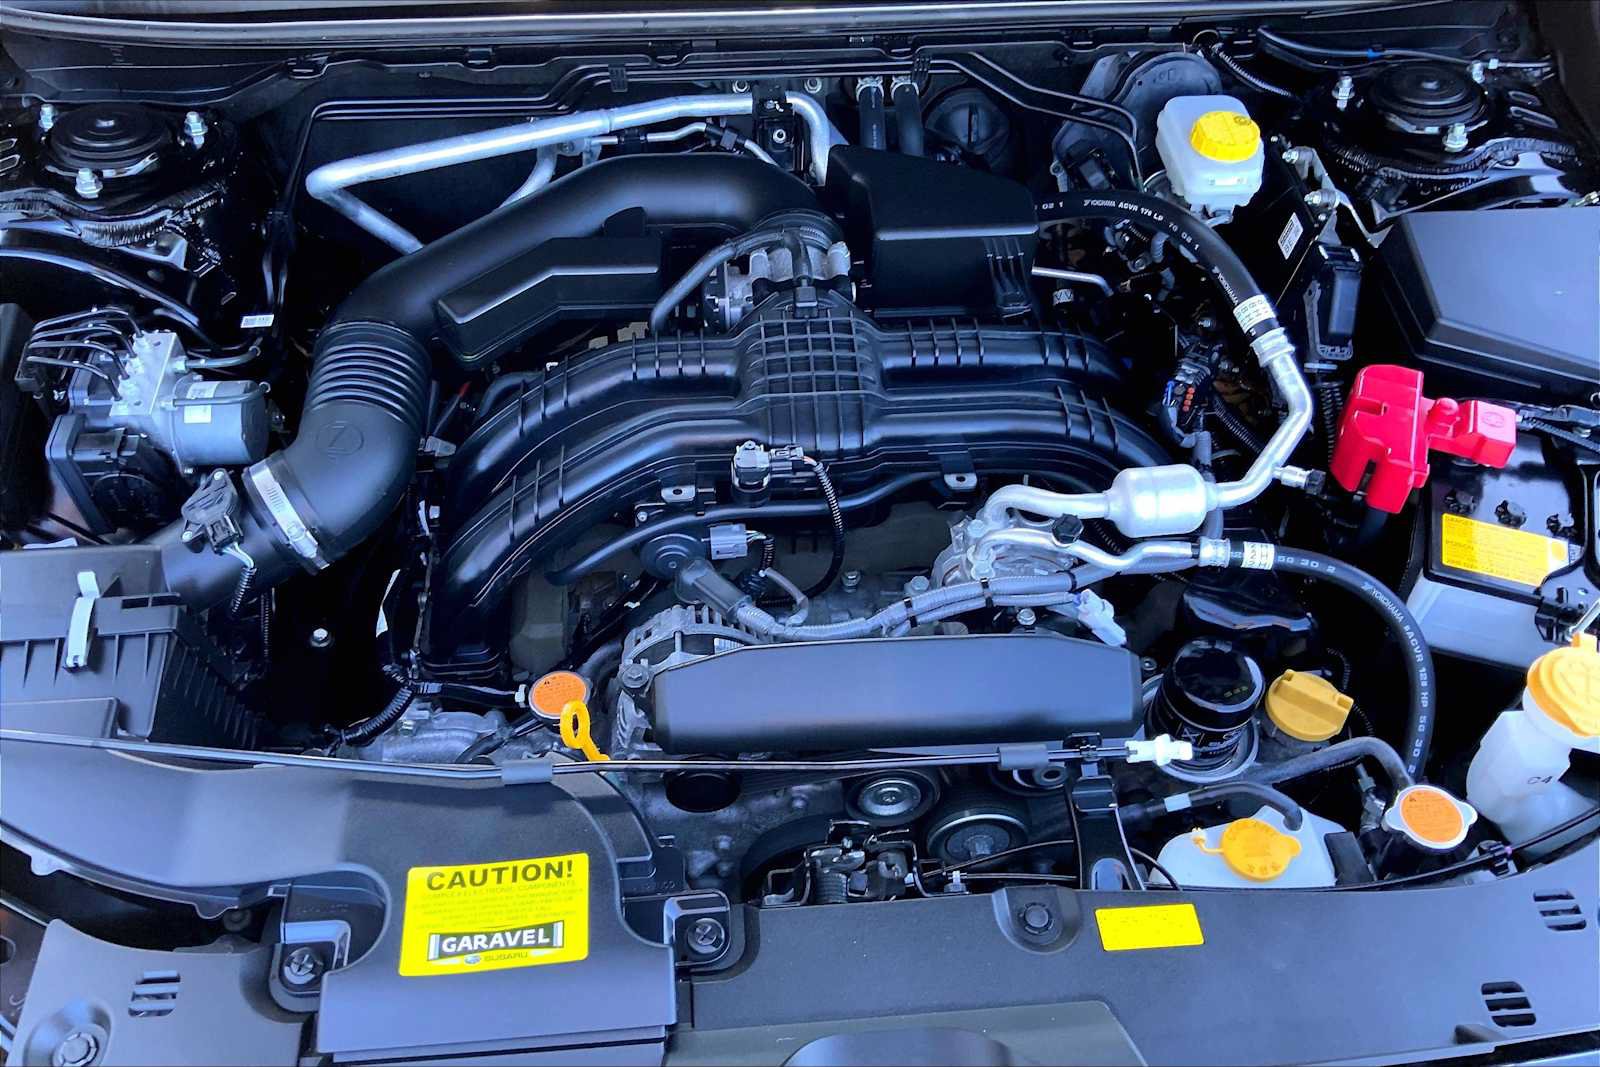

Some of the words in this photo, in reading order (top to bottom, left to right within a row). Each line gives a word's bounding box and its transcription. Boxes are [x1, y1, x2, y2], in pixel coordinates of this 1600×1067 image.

[1372, 588, 1405, 623] YOKOHAMA
[427, 860, 573, 891] CAUTION!
[441, 927, 550, 953] GARAVEL
